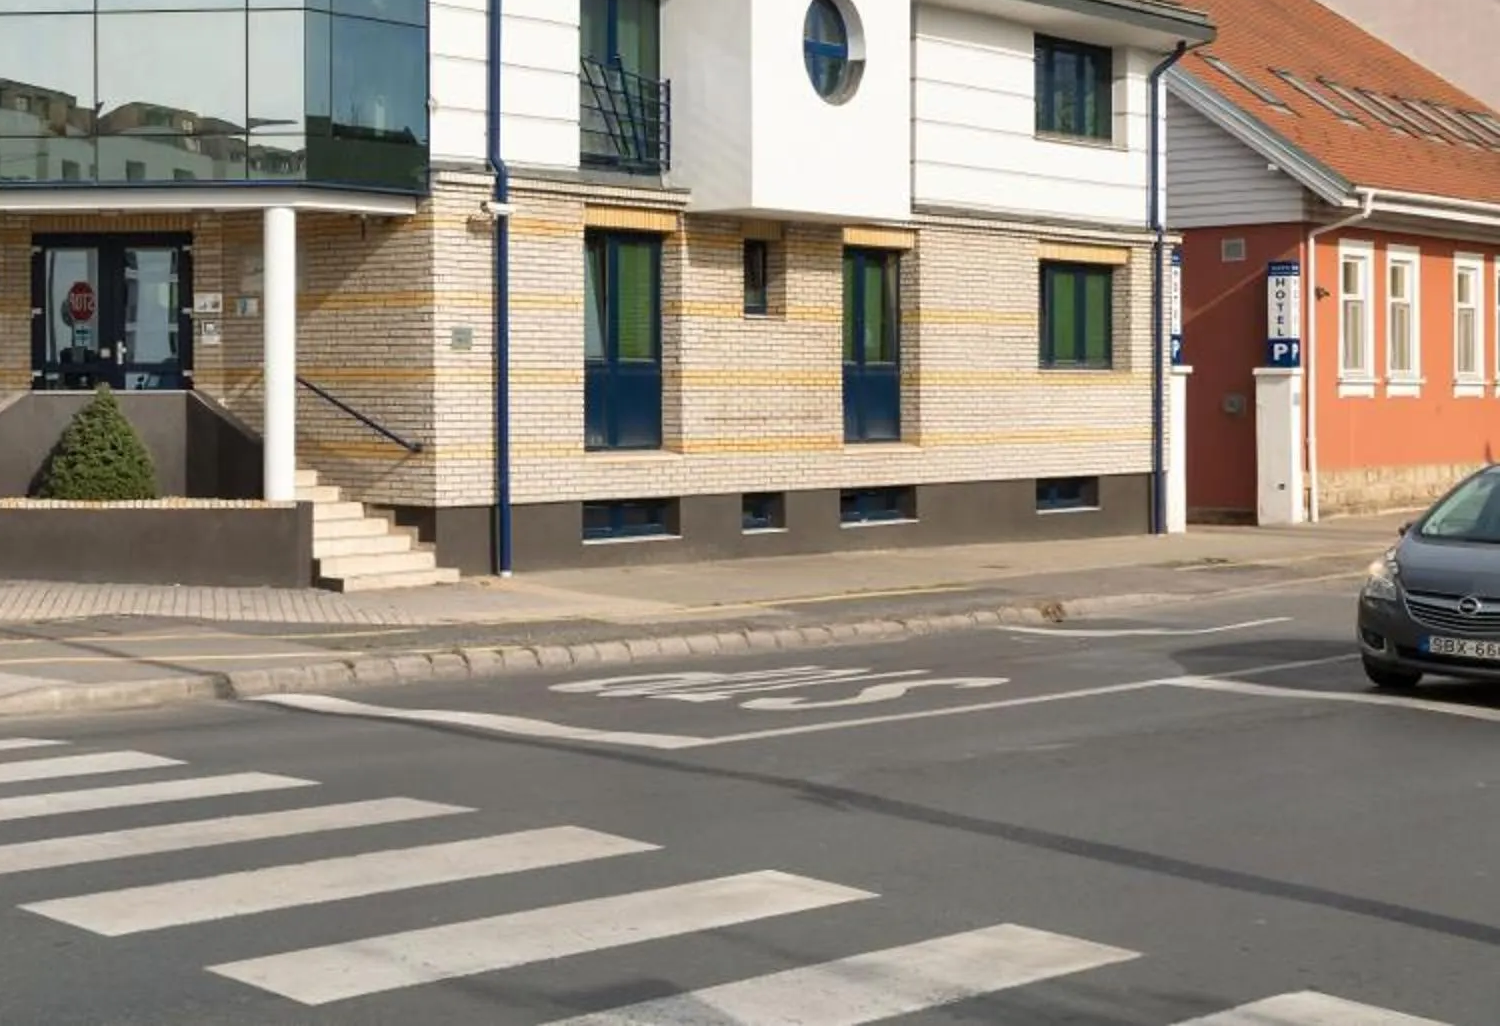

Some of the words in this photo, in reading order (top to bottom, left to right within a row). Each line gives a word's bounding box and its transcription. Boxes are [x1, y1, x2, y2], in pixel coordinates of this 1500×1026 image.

[1275, 278, 1286, 336] HOTEL
[1273, 343, 1288, 360] P
[1432, 637, 1500, 657] SBX-66
